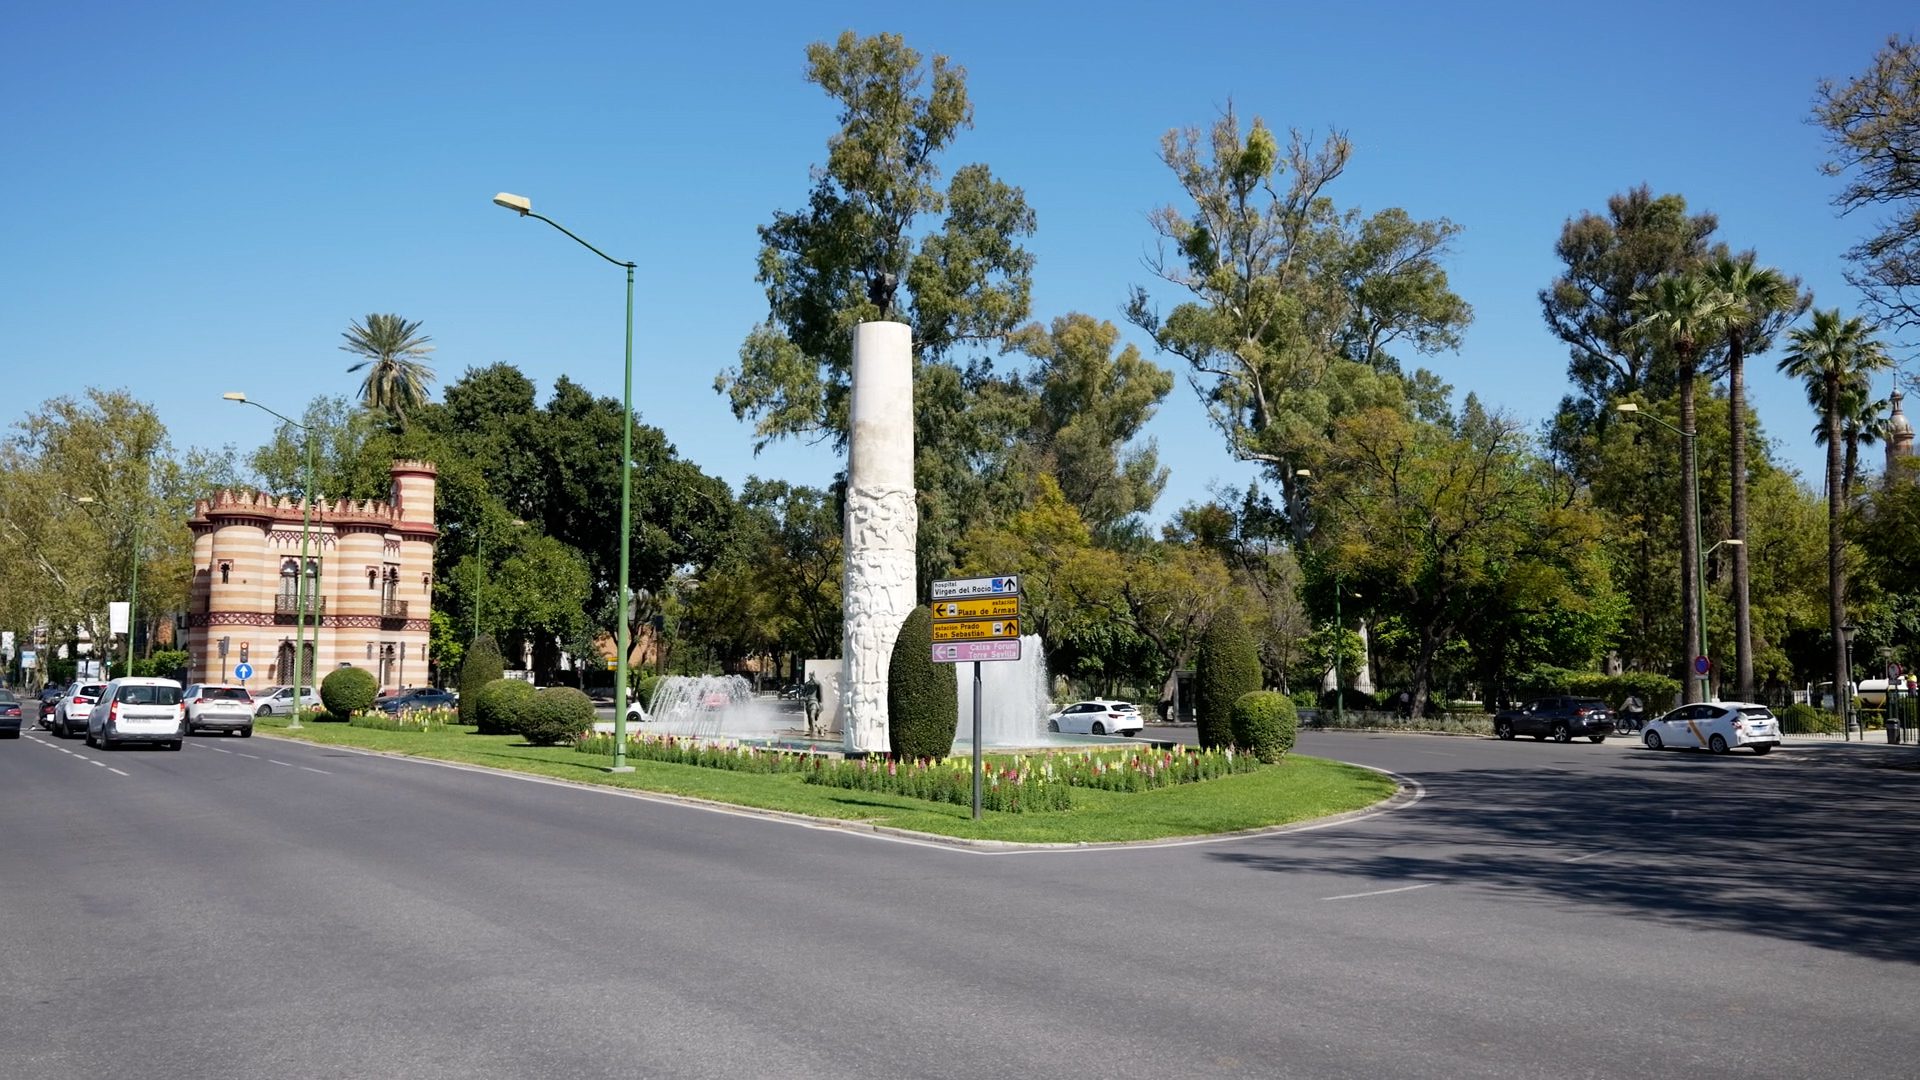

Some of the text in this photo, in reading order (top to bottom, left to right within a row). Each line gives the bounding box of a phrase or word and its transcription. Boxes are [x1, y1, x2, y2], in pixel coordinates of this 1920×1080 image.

[935, 588, 957, 596] Virgen
[959, 586, 970, 594] del
[969, 642, 1017, 651] Caixa Forum
[991, 650, 1016, 658] Sevilla
